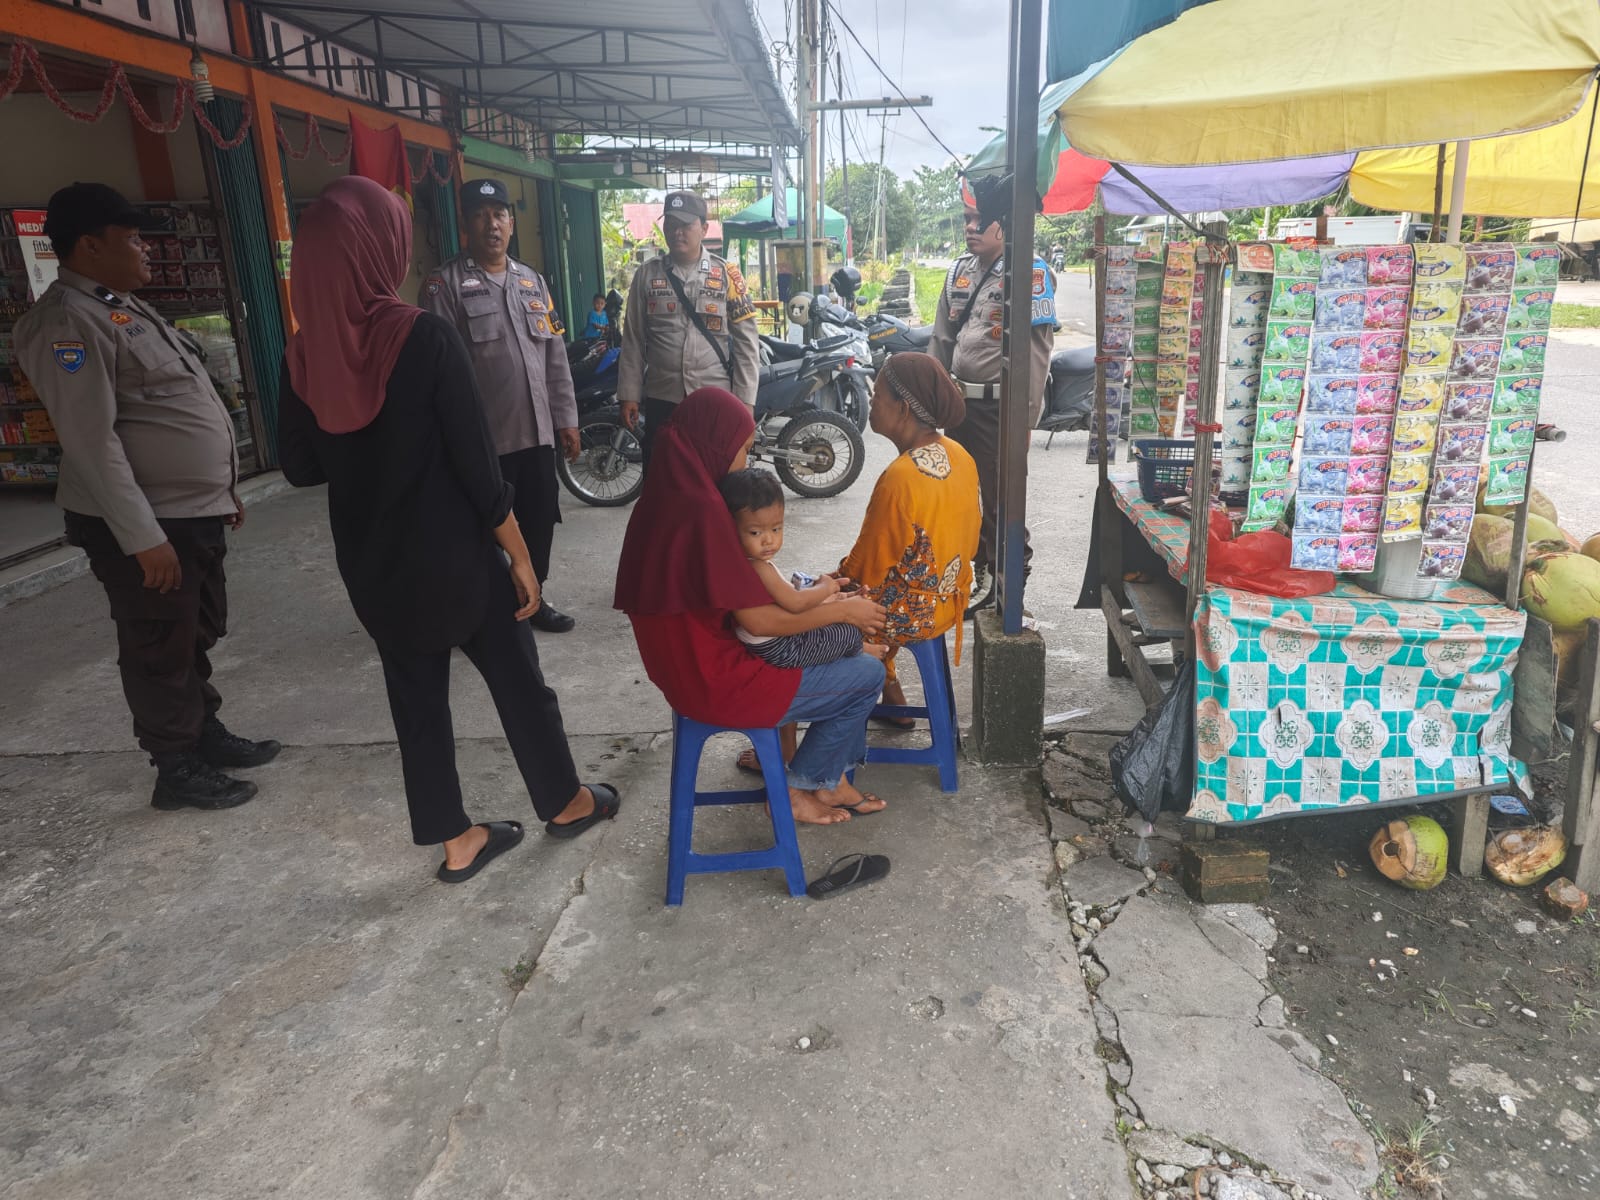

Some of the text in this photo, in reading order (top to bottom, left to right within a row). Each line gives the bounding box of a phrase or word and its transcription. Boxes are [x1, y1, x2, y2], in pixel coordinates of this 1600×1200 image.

[1338, 252, 1350, 262] POP
[1384, 250, 1394, 260] POP
[1530, 249, 1543, 260] POP
[1486, 255, 1499, 266] POP
[520, 288, 541, 298] POLRI
[1291, 282, 1304, 294] POP
[700, 290, 724, 299] POLRI
[1337, 293, 1364, 306] POP ICE
[1382, 292, 1393, 305] POP
[1525, 292, 1539, 304] POP
[1480, 300, 1494, 310] POP
[1284, 326, 1296, 336] POP
[1332, 337, 1345, 349] POP
[1375, 336, 1386, 348] POP
[1519, 336, 1533, 348] POP
[1472, 345, 1485, 356] POP
[1280, 368, 1291, 380] POP
[1328, 380, 1342, 392] POP
[1370, 380, 1382, 392] POP
[1513, 379, 1528, 391] POP
[1464, 387, 1478, 398] POP
[1274, 410, 1286, 422] POP
[1324, 421, 1339, 432] POP
[1365, 420, 1377, 432] POP
[1508, 421, 1522, 432] POP
[1458, 429, 1472, 438] POP
[1268, 450, 1279, 462] POP
[1320, 461, 1334, 472] POP
[1361, 461, 1373, 472] POP
[1505, 462, 1516, 473] POP
[1451, 470, 1465, 479] POP
[1264, 490, 1274, 500] POP
[1316, 500, 1328, 512] POP
[1356, 500, 1369, 511] POP
[1444, 510, 1456, 519] POP
[1312, 538, 1324, 549] POP
[1352, 538, 1363, 550] POP
[1439, 548, 1450, 557] POP
